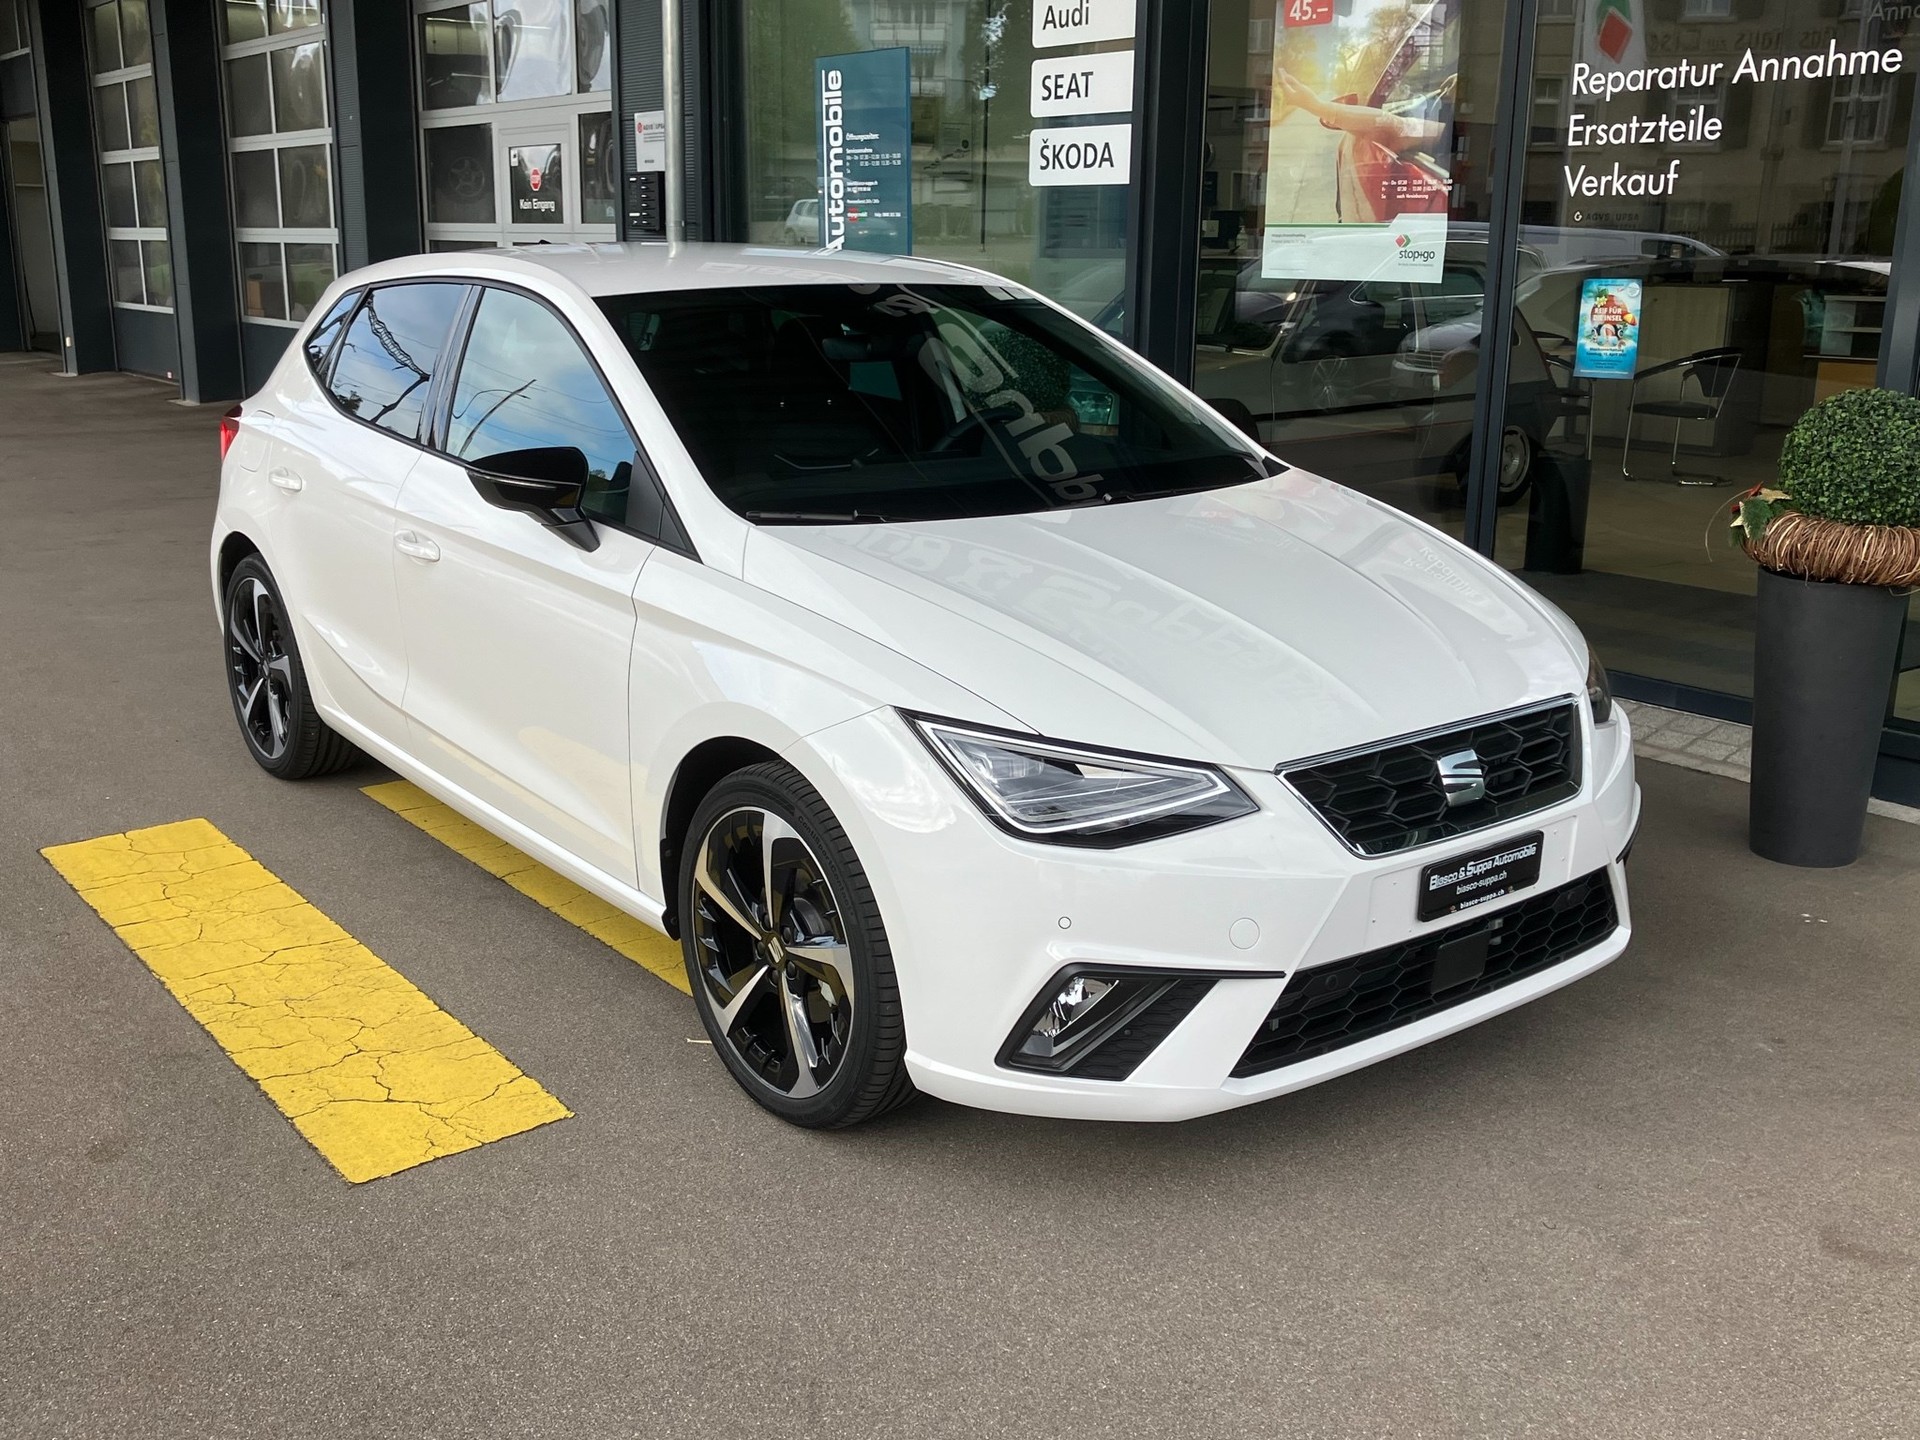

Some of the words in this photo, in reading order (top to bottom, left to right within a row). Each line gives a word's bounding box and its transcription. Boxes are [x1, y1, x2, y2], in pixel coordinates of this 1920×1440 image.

[1043, 0, 1090, 31] Audi
[1572, 58, 1724, 102] Reparatur
[1731, 38, 1903, 85] Annahme
[1041, 71, 1094, 101] SEAT
[1567, 104, 1723, 147] Ersatzteile
[1040, 137, 1115, 171] ŠKODA
[1563, 158, 1681, 198] Verkauf
[519, 198, 532, 210] Kein
[532, 198, 556, 212] Eingang
[1399, 249, 1436, 263] stop+go
[1609, 305, 1623, 315] FÜR
[1429, 871, 1458, 891] Biasco
[1458, 866, 1466, 879] &
[1466, 861, 1493, 877] Suppa
[1493, 844, 1538, 868] Automobile
[1456, 870, 1508, 895] biasco-suppa.ch
[1460, 889, 1505, 910] biasco-suppa.ch
